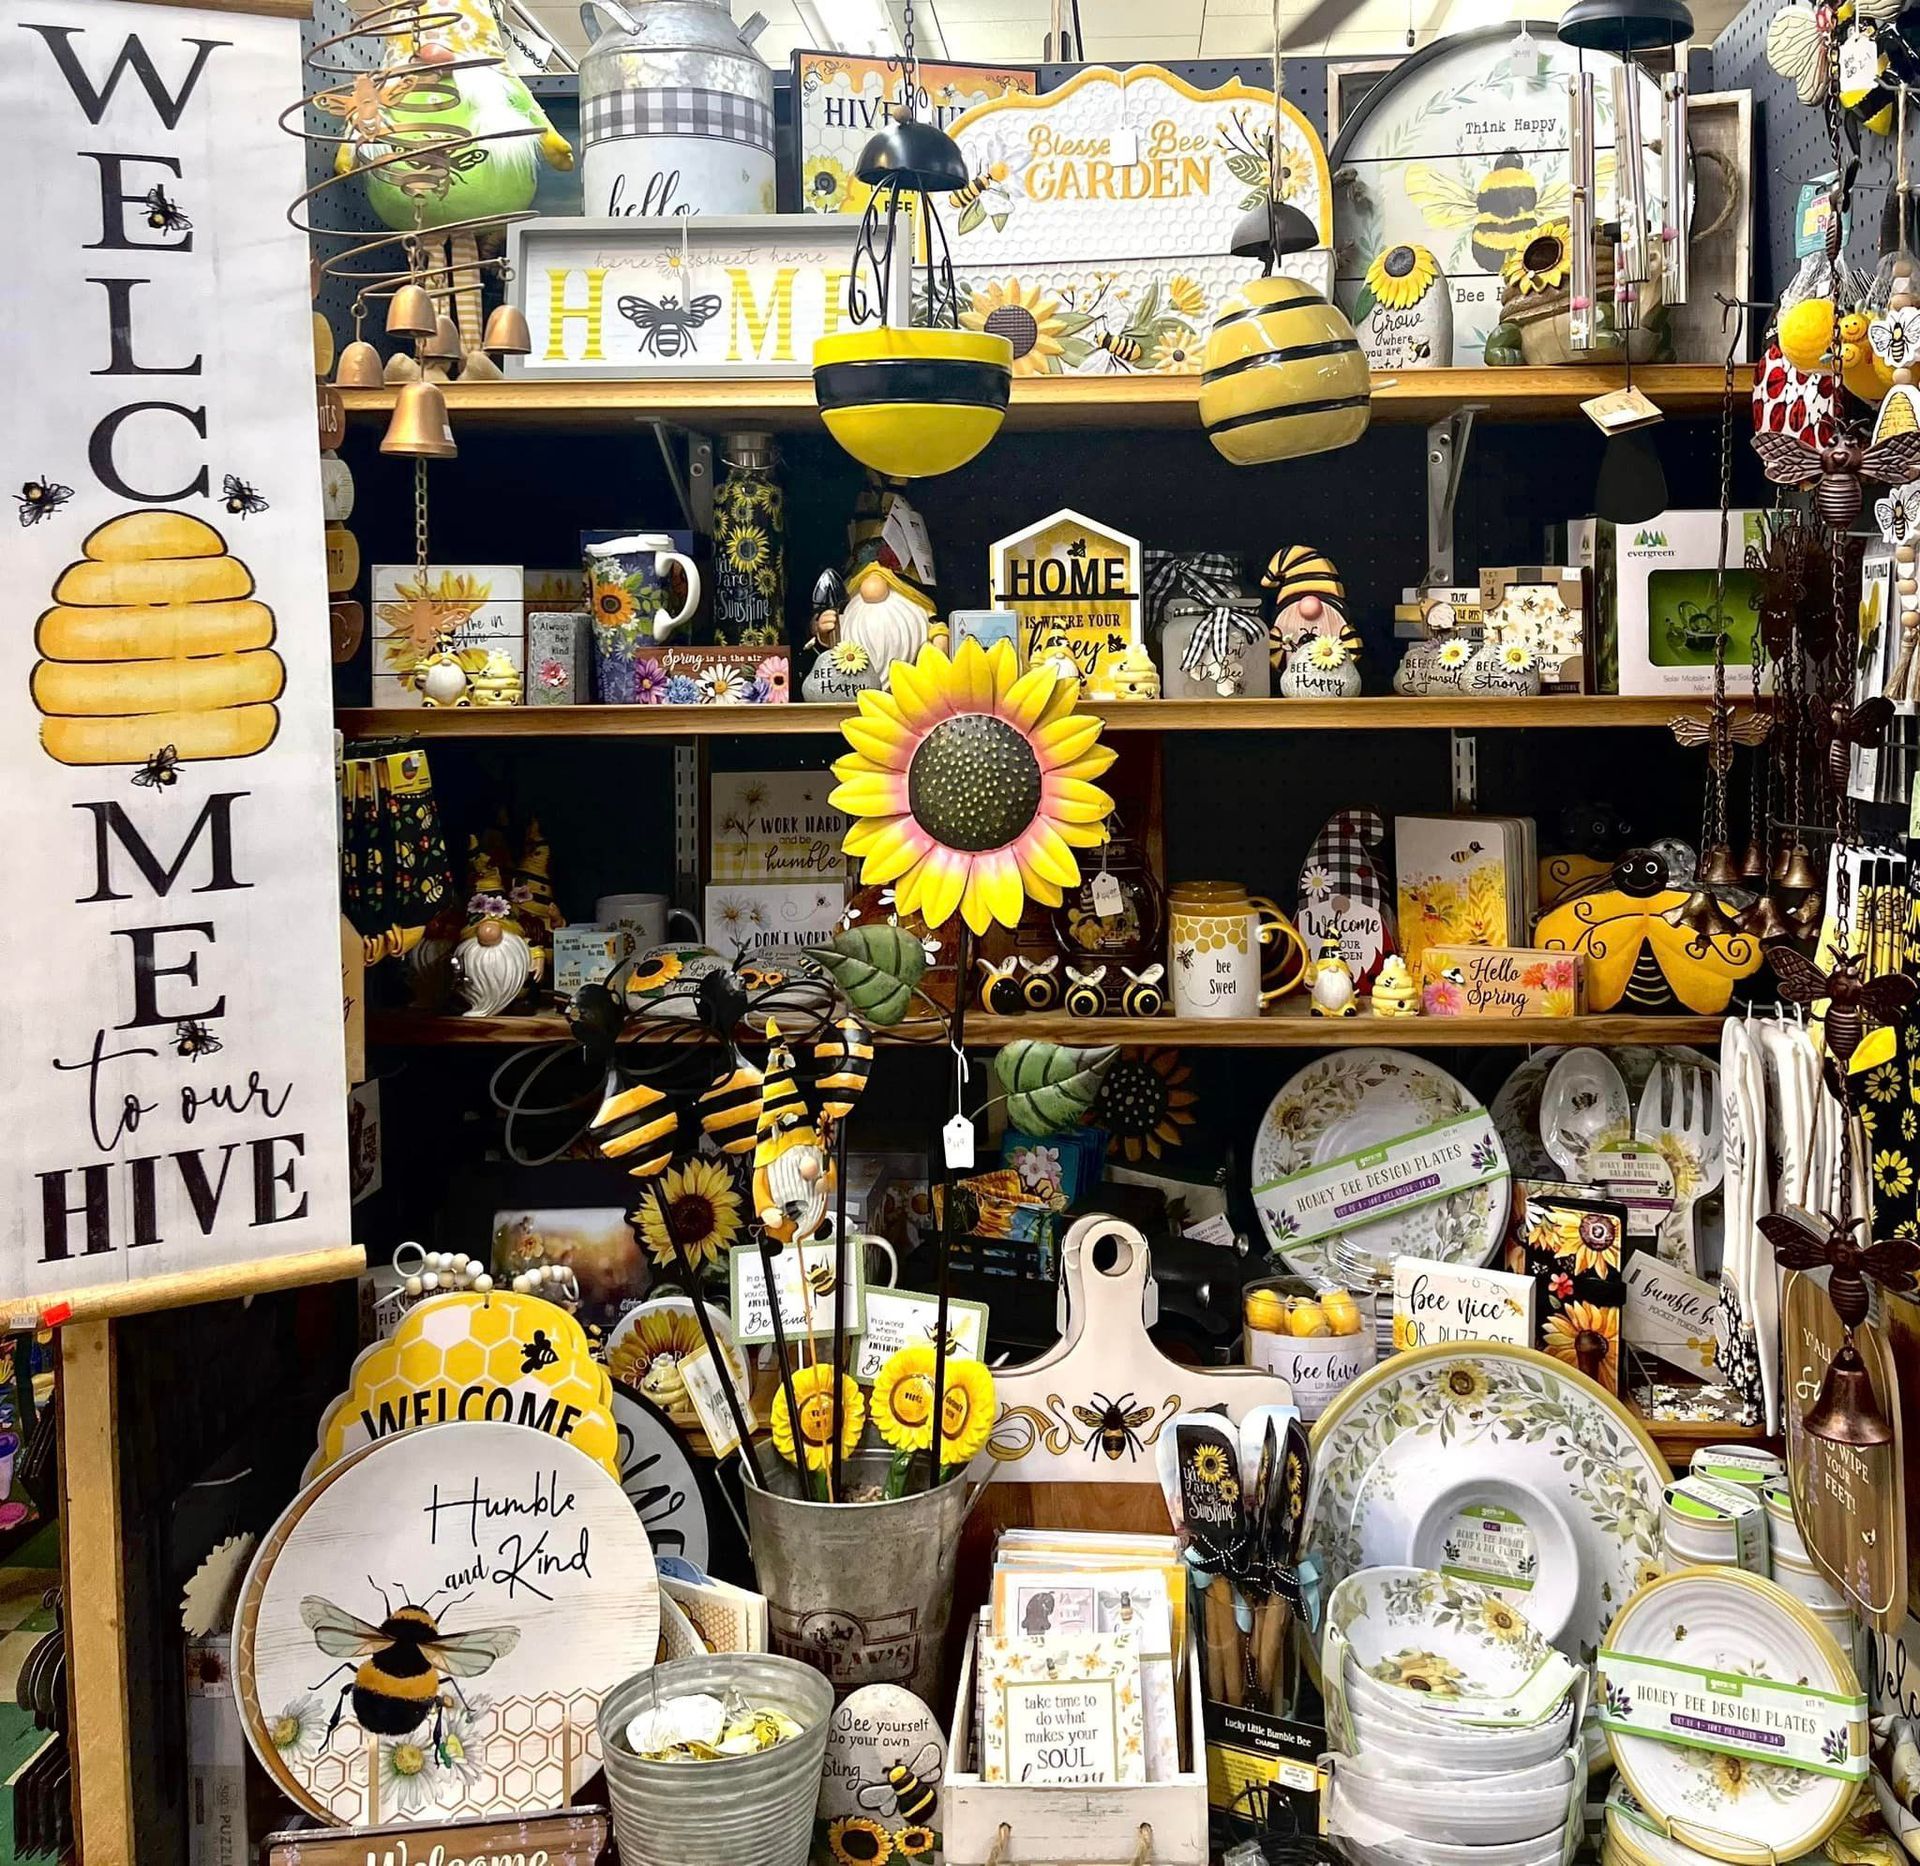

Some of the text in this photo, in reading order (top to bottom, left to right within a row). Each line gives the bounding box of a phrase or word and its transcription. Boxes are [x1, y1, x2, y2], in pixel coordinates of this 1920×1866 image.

[1028, 120, 1209, 158] Blesse Bee
[1464, 116, 1557, 136] Think Happy
[1024, 156, 1212, 201] GARDEN
[608, 170, 700, 216] hello
[769, 245, 828, 264] home
[1455, 287, 1485, 302] Bee
[1372, 309, 1424, 346] Grow
[1383, 335, 1413, 346] where
[1386, 348, 1401, 356] are
[1010, 558, 1125, 597] HOME
[1485, 588, 1496, 600] 4
[540, 623, 569, 631] Always
[1025, 616, 1038, 629] IS
[1089, 614, 1120, 628] YOUR
[662, 649, 705, 671] Spring
[730, 654, 747, 662] the
[748, 654, 762, 663] air
[1029, 620, 1106, 675] hey
[814, 668, 833, 678] BEE
[1291, 662, 1308, 673] BEE
[1476, 661, 1496, 671] BEE
[820, 680, 867, 698] Happy
[1296, 670, 1345, 696] Happy
[1416, 671, 1463, 693] Yourself
[1472, 674, 1530, 695] Strong
[761, 817, 799, 834] WORK
[805, 815, 841, 833] HARD
[779, 835, 811, 844] and be
[764, 841, 841, 872] humble
[1305, 910, 1380, 939] Welcome
[755, 930, 789, 948] DON'T
[1216, 959, 1232, 974] bee
[1343, 952, 1363, 960] DEN
[1469, 956, 1521, 982] Hello
[1209, 978, 1237, 995] Sweet
[1467, 980, 1529, 1017] Spring
[53, 1029, 293, 1151] to our
[1296, 1143, 1463, 1212] HONEY BEE DESIGN PLATES
[34, 1133, 309, 1264] HIVE
[1399, 1275, 1505, 1324] bee nice
[1640, 1278, 1716, 1325] bumble be
[1405, 1320, 1427, 1347] OR
[1648, 1305, 1706, 1336] POCKET TOKENS
[1293, 1355, 1361, 1384] bee hive
[361, 1386, 582, 1441] WELCOME
[1824, 1452, 1851, 1487] YOUR
[1838, 1443, 1870, 1484] WIPE
[1824, 1472, 1857, 1515] FEET!
[424, 1470, 575, 1547] Humble
[445, 1527, 591, 1600] and Kind
[1025, 1694, 1097, 1710] take time to
[1637, 1685, 1817, 1735] HONEY BEE DESIGN PLATES
[839, 1708, 930, 1734] Bee yourself
[1036, 1710, 1086, 1726] do what
[849, 1735, 879, 1748] your
[882, 1736, 910, 1748] own
[1025, 1727, 1099, 1747] makes your
[1225, 1717, 1312, 1748] Lucky Little Bumble Bee
[822, 1752, 861, 1792] Sting
[1037, 1748, 1094, 1770] SOUL
